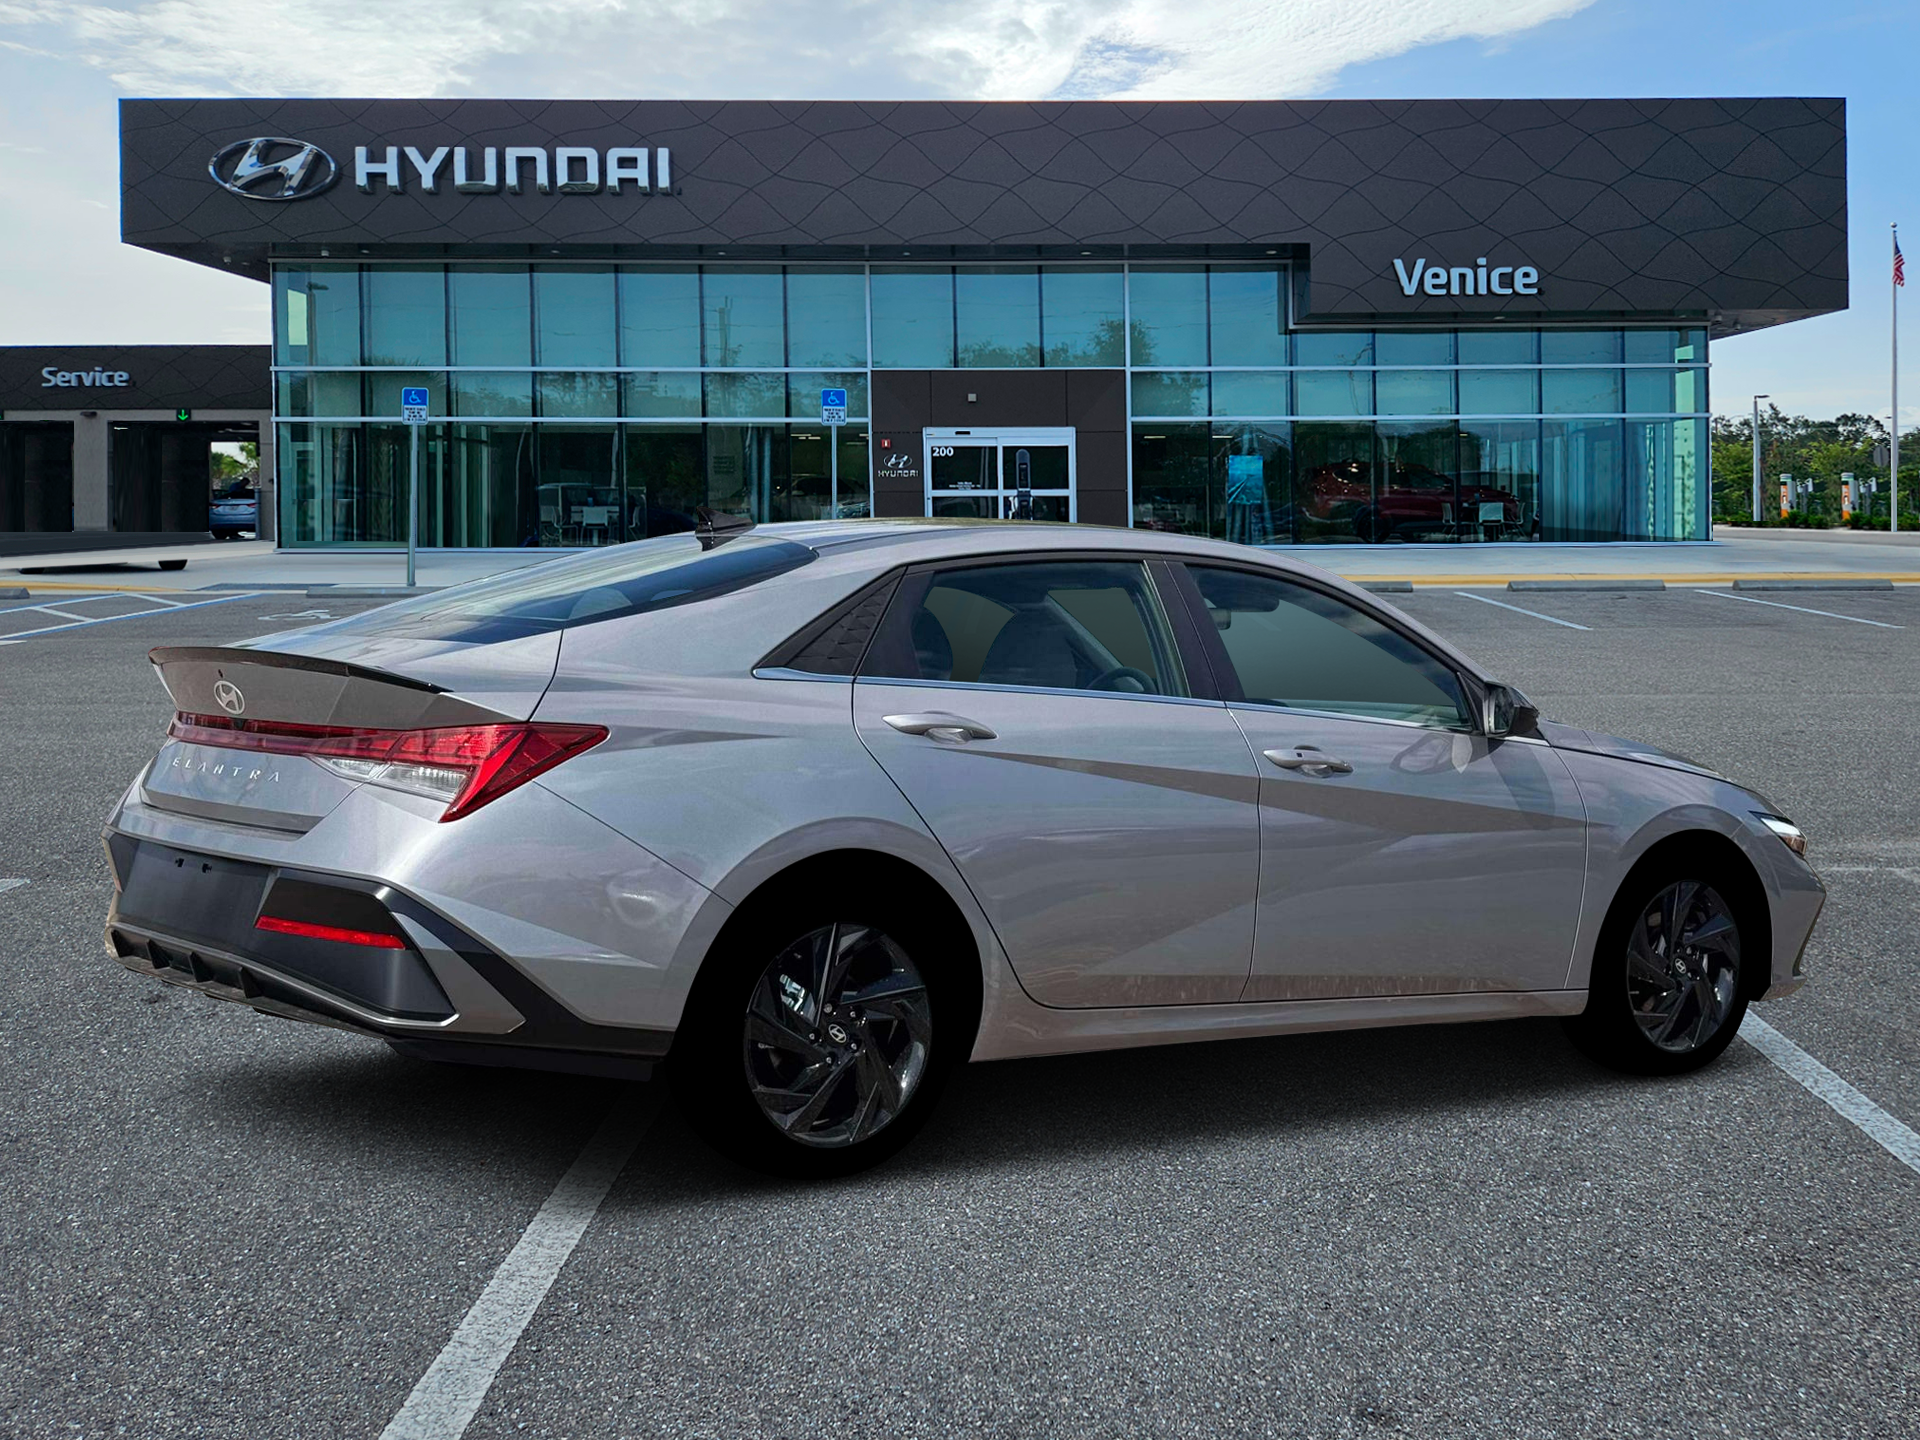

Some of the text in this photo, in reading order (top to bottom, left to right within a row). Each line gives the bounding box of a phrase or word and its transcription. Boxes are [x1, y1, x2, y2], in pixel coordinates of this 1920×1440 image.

[354, 145, 674, 194] HYUNDAI
[1392, 256, 1539, 296] Venice
[41, 366, 130, 387] Service
[932, 446, 954, 457] 200
[877, 469, 919, 478] HYUNDAI
[172, 756, 280, 782] ELANTRA
